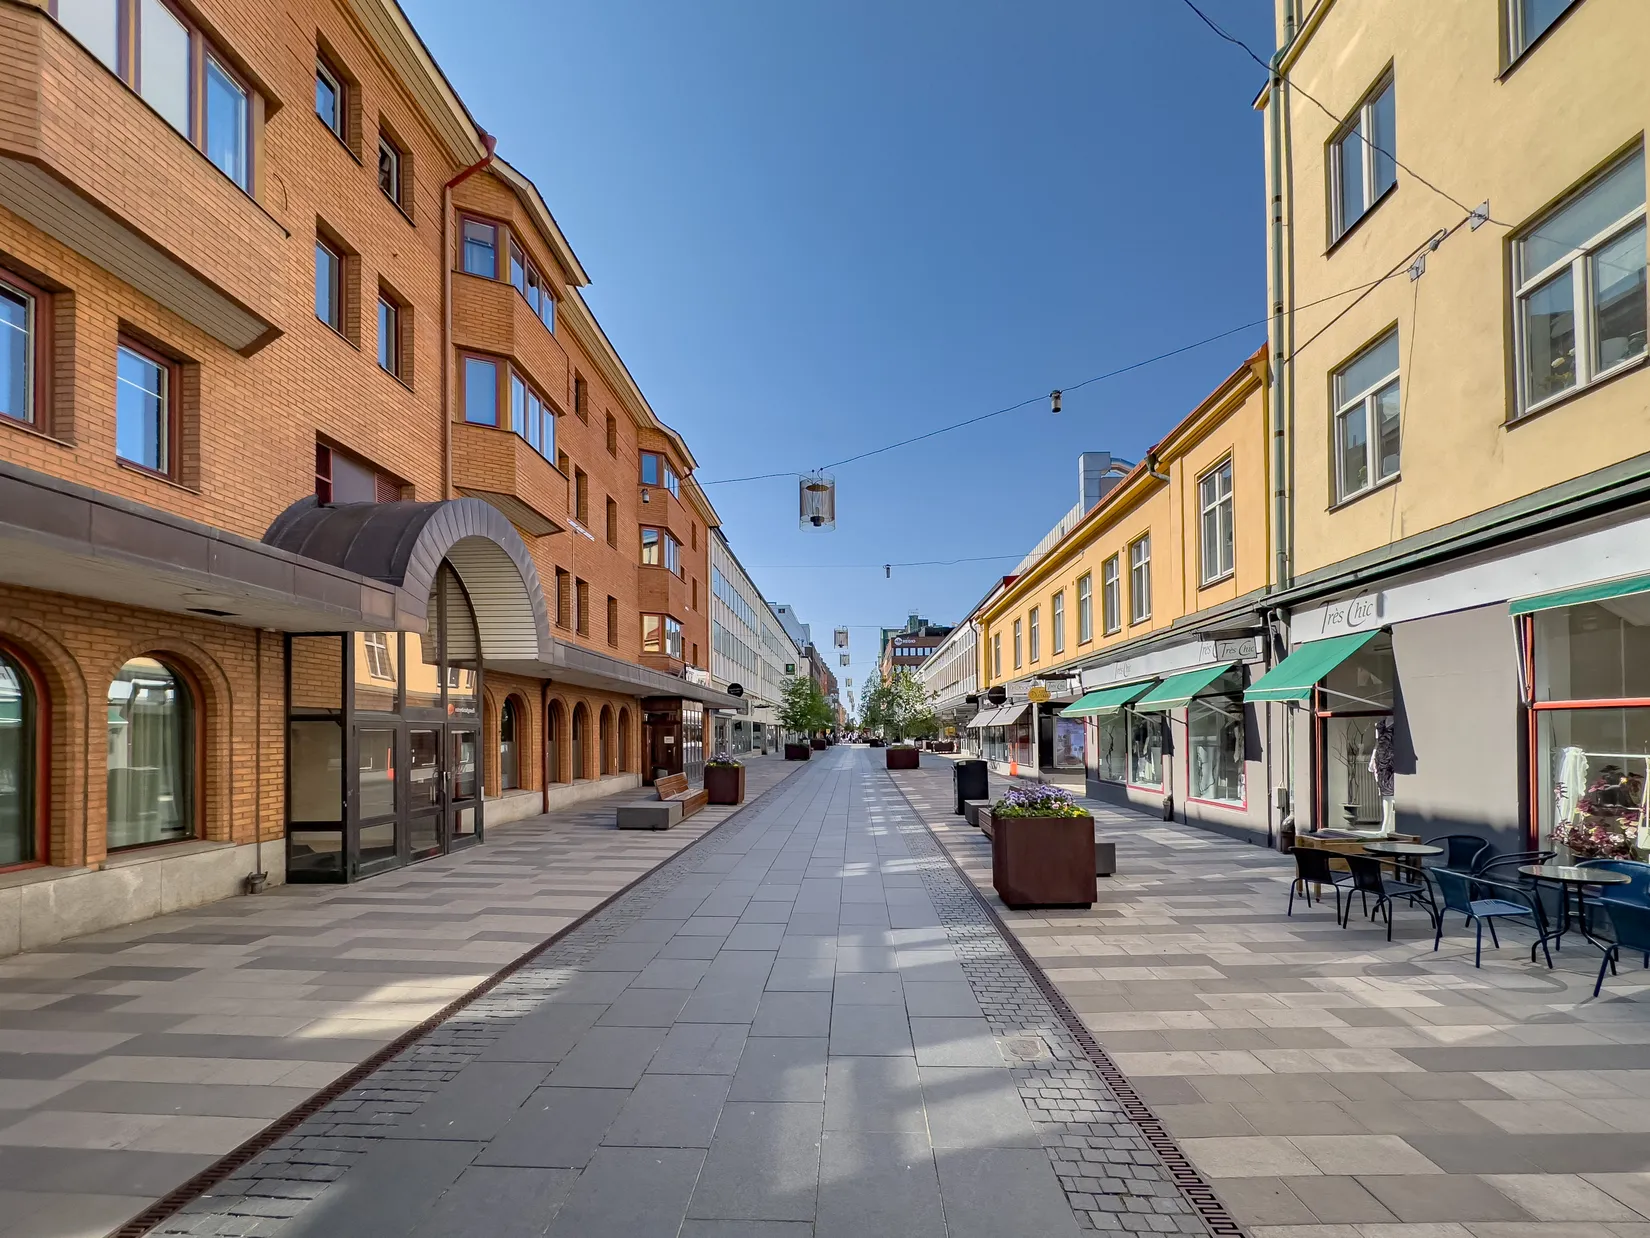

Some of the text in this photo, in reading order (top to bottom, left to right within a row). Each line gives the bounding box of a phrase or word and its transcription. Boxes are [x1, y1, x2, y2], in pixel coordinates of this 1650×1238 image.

[1318, 589, 1373, 634] Très Chic
[1218, 642, 1237, 658] Très
[1238, 640, 1255, 656] Chic
